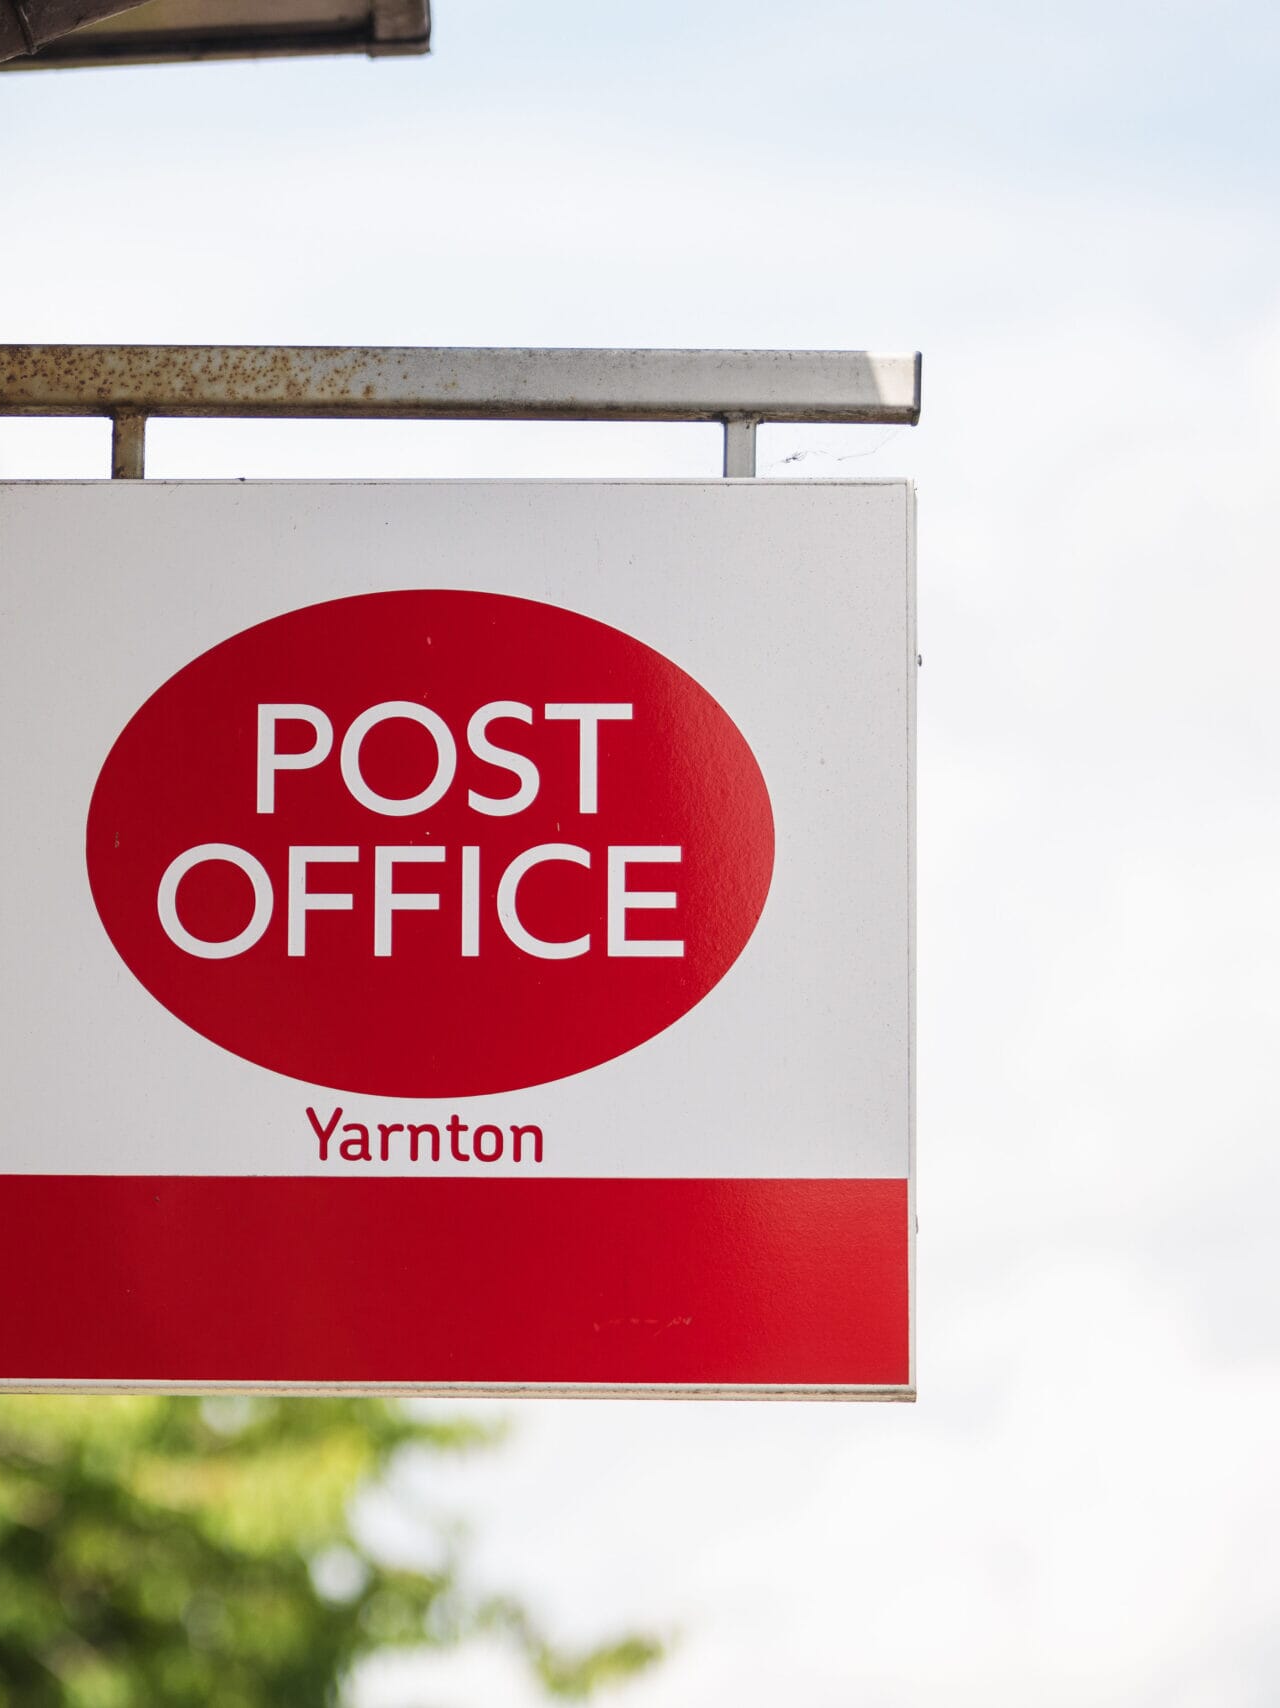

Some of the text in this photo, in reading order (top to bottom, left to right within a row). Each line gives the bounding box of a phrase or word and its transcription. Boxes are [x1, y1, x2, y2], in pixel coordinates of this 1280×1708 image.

[257, 701, 632, 816] POST
[158, 843, 684, 959] OFFICE
[306, 1107, 543, 1162] Yarnton
